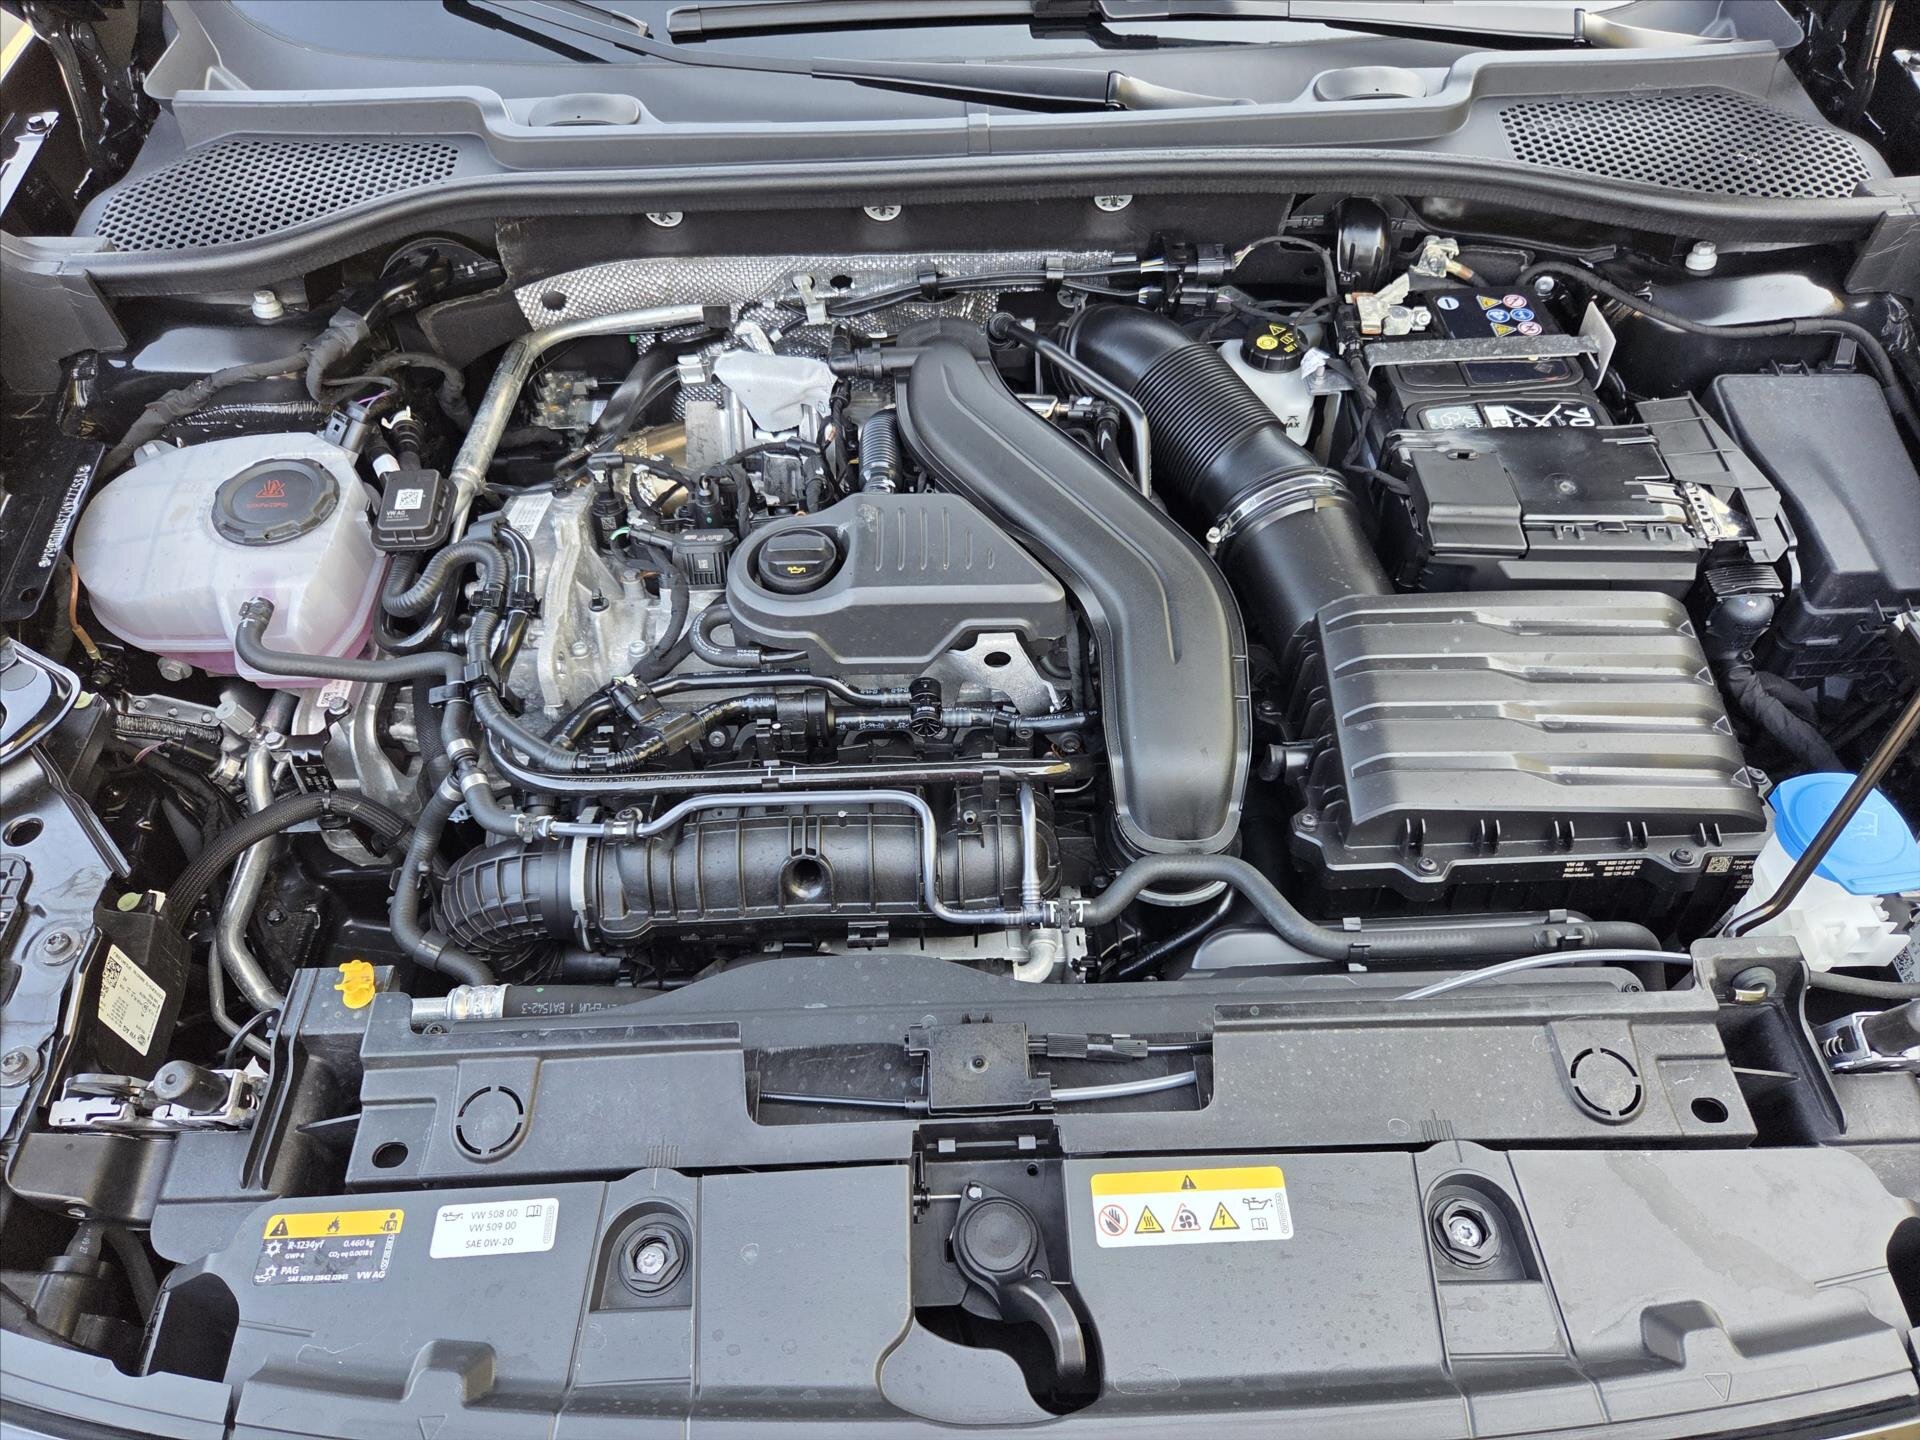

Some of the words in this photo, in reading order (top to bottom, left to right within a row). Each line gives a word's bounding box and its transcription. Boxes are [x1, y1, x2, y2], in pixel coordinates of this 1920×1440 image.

[471, 1211, 486, 1220] VW
[488, 1209, 505, 1219] 508
[506, 1208, 519, 1217] 00
[469, 1224, 484, 1233] VW
[486, 1222, 503, 1232] 509
[505, 1221, 517, 1230] 00
[287, 1239, 326, 1251] R-1234yf
[343, 1239, 366, 1247] 0.460
[365, 1239, 375, 1248] kg
[465, 1239, 482, 1249] SAE
[484, 1237, 514, 1248] 0W-20
[280, 1266, 299, 1275] PAG
[356, 1271, 371, 1280] VW
[371, 1270, 386, 1279] AG
